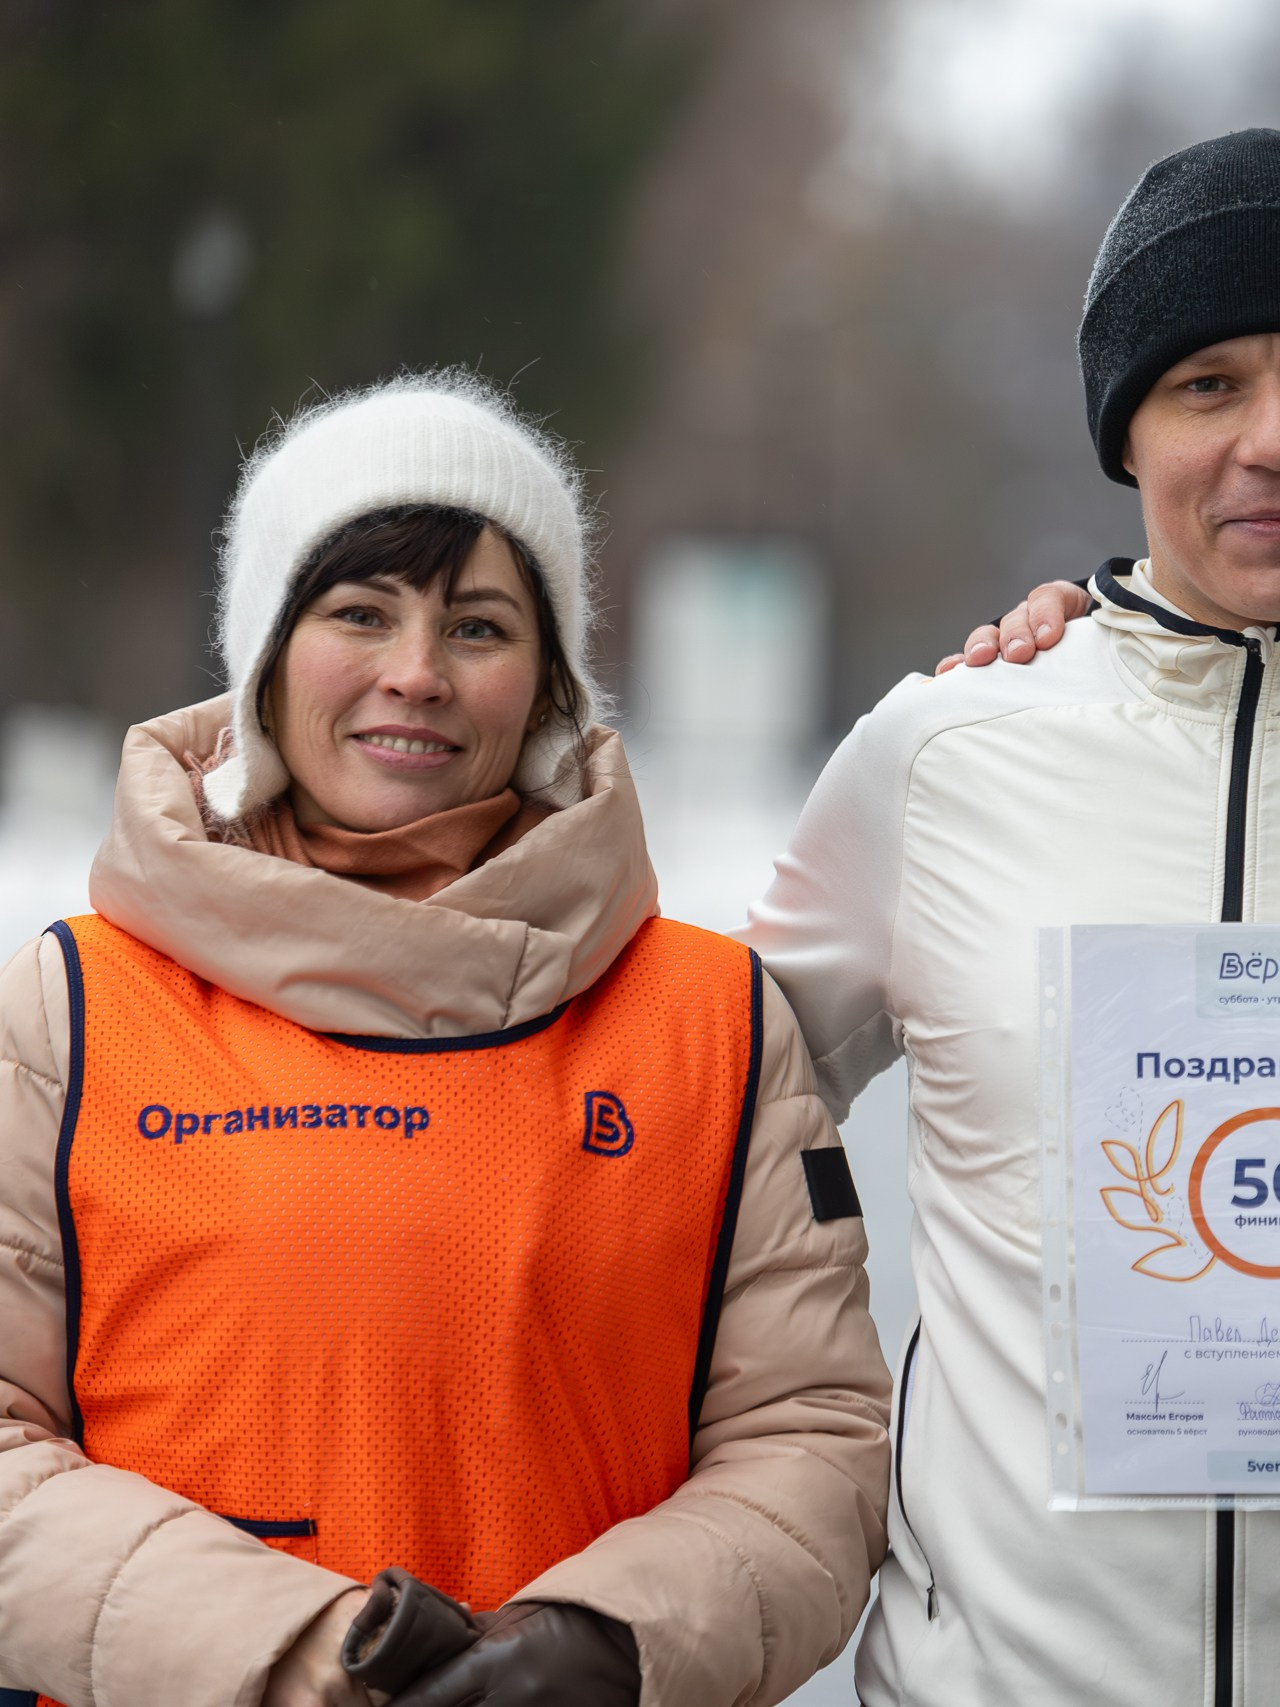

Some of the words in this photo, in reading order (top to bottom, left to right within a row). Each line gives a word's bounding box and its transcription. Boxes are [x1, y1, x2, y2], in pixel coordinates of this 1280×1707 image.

[1219, 995, 1259, 1005] суббота
[137, 1103, 431, 1145] Организатор
[1189, 1315, 1243, 1342] Павел
[1184, 1350, 1192, 1359] с
[1126, 1413, 1166, 1421] Максим
[1169, 1413, 1204, 1422] Егоров
[1126, 1428, 1175, 1436] основатель
